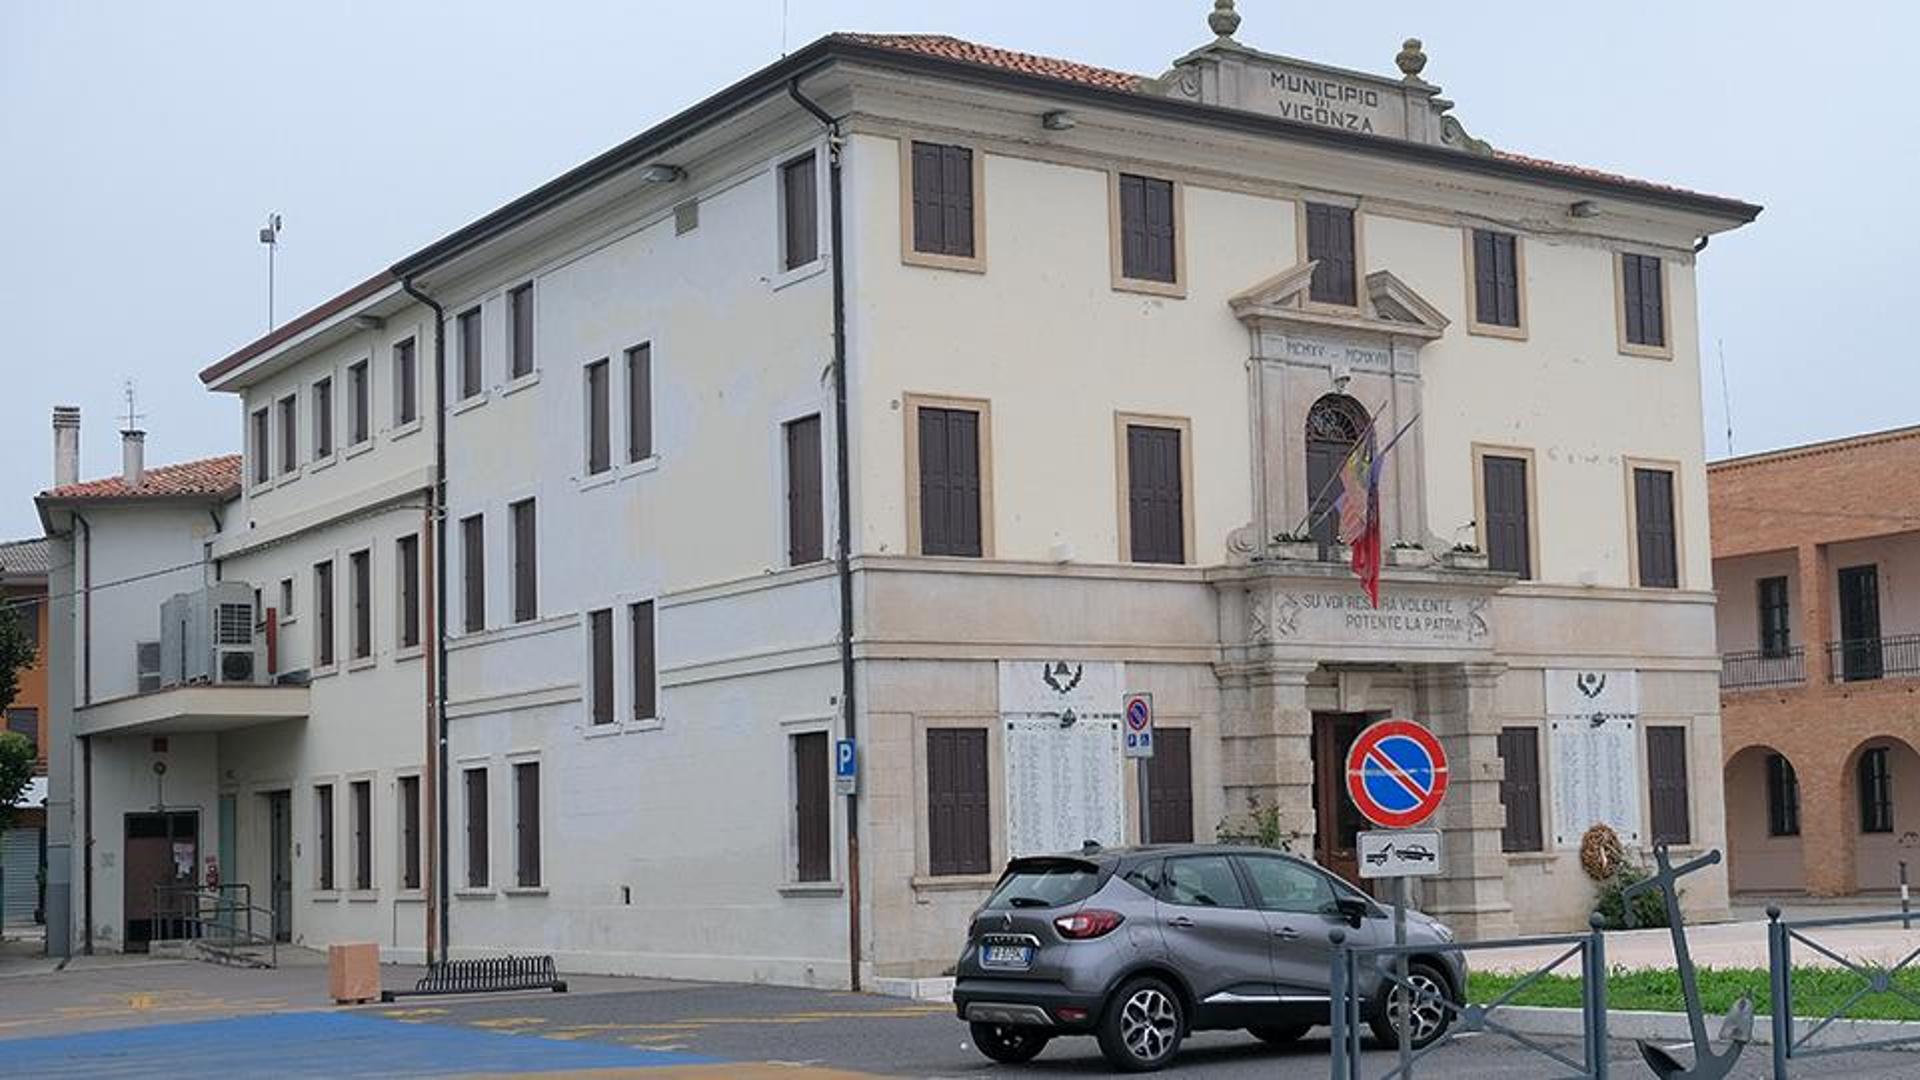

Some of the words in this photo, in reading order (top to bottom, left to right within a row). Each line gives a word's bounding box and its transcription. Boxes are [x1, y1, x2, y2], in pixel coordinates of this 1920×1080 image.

[1270, 71, 1379, 108] MUNICIPIO
[1278, 100, 1374, 134] VIGONZA
[1303, 593, 1320, 609] SU
[1323, 594, 1343, 609] VOI
[1400, 597, 1453, 613] VOLENTE
[1346, 614, 1401, 631] POTENTE
[1406, 616, 1420, 630] LA
[1424, 616, 1463, 632] PATRIA
[840, 743, 852, 773] P
